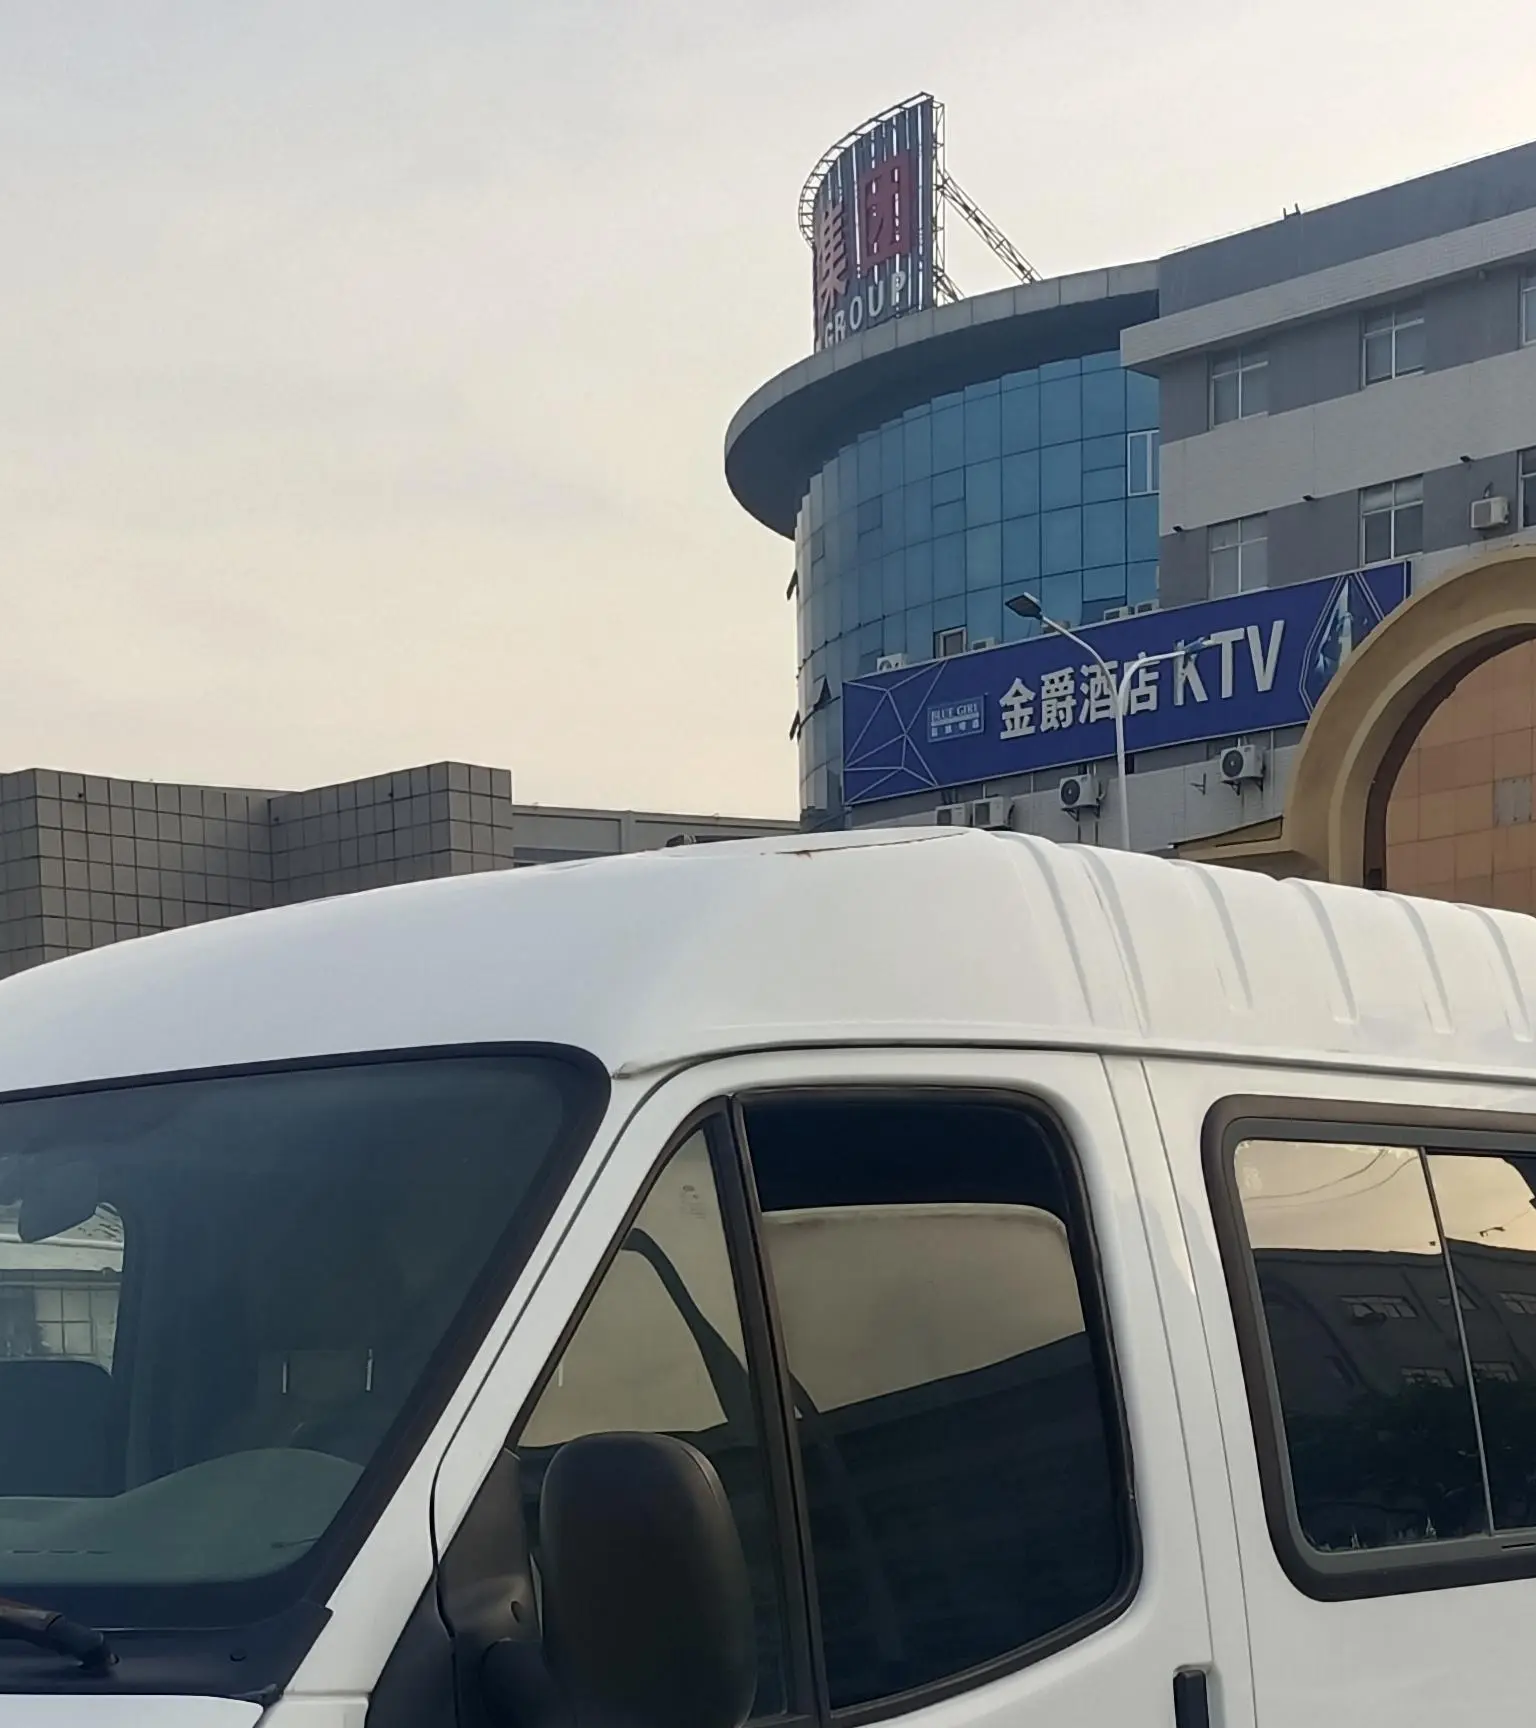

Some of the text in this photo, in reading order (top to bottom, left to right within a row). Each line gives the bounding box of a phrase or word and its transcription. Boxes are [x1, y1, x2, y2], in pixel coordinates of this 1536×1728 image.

[824, 271, 907, 349] GROUP
[998, 619, 1286, 740] 金爵酒店 KTV
